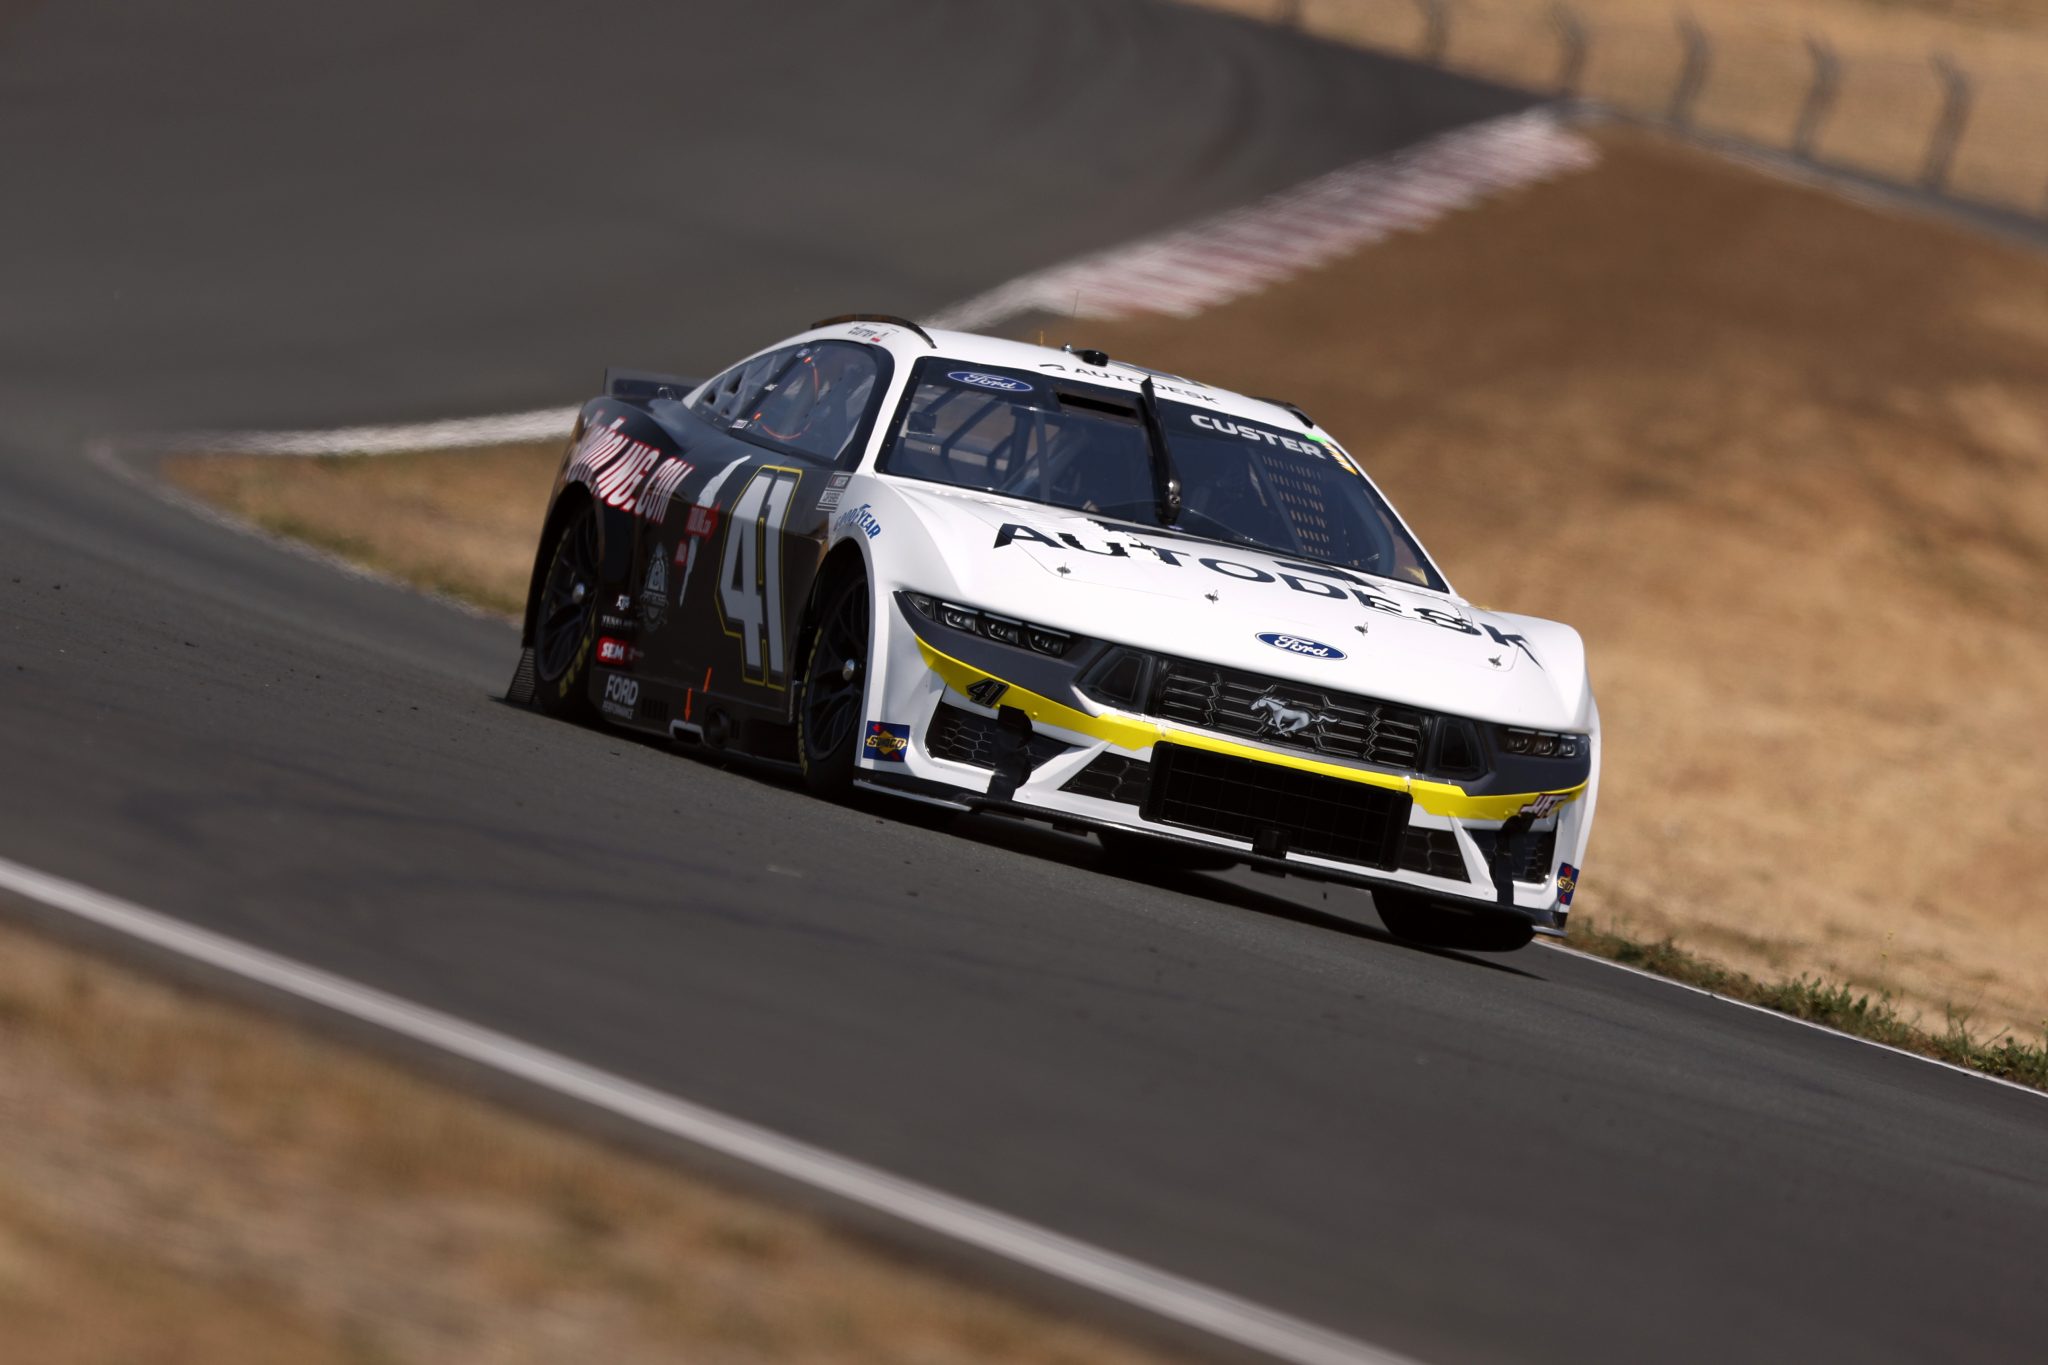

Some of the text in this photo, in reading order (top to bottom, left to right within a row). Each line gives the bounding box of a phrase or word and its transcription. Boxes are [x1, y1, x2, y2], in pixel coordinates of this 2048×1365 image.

[964, 374, 1017, 389] Ford
[1190, 414, 1327, 460] CUSTER
[833, 505, 882, 540] GOODYEAR
[716, 465, 802, 690] 41
[993, 522, 1546, 673] AUTODESK
[1274, 635, 1329, 657] Ford
[605, 674, 639, 706] FORD
[966, 678, 1009, 709] 41
